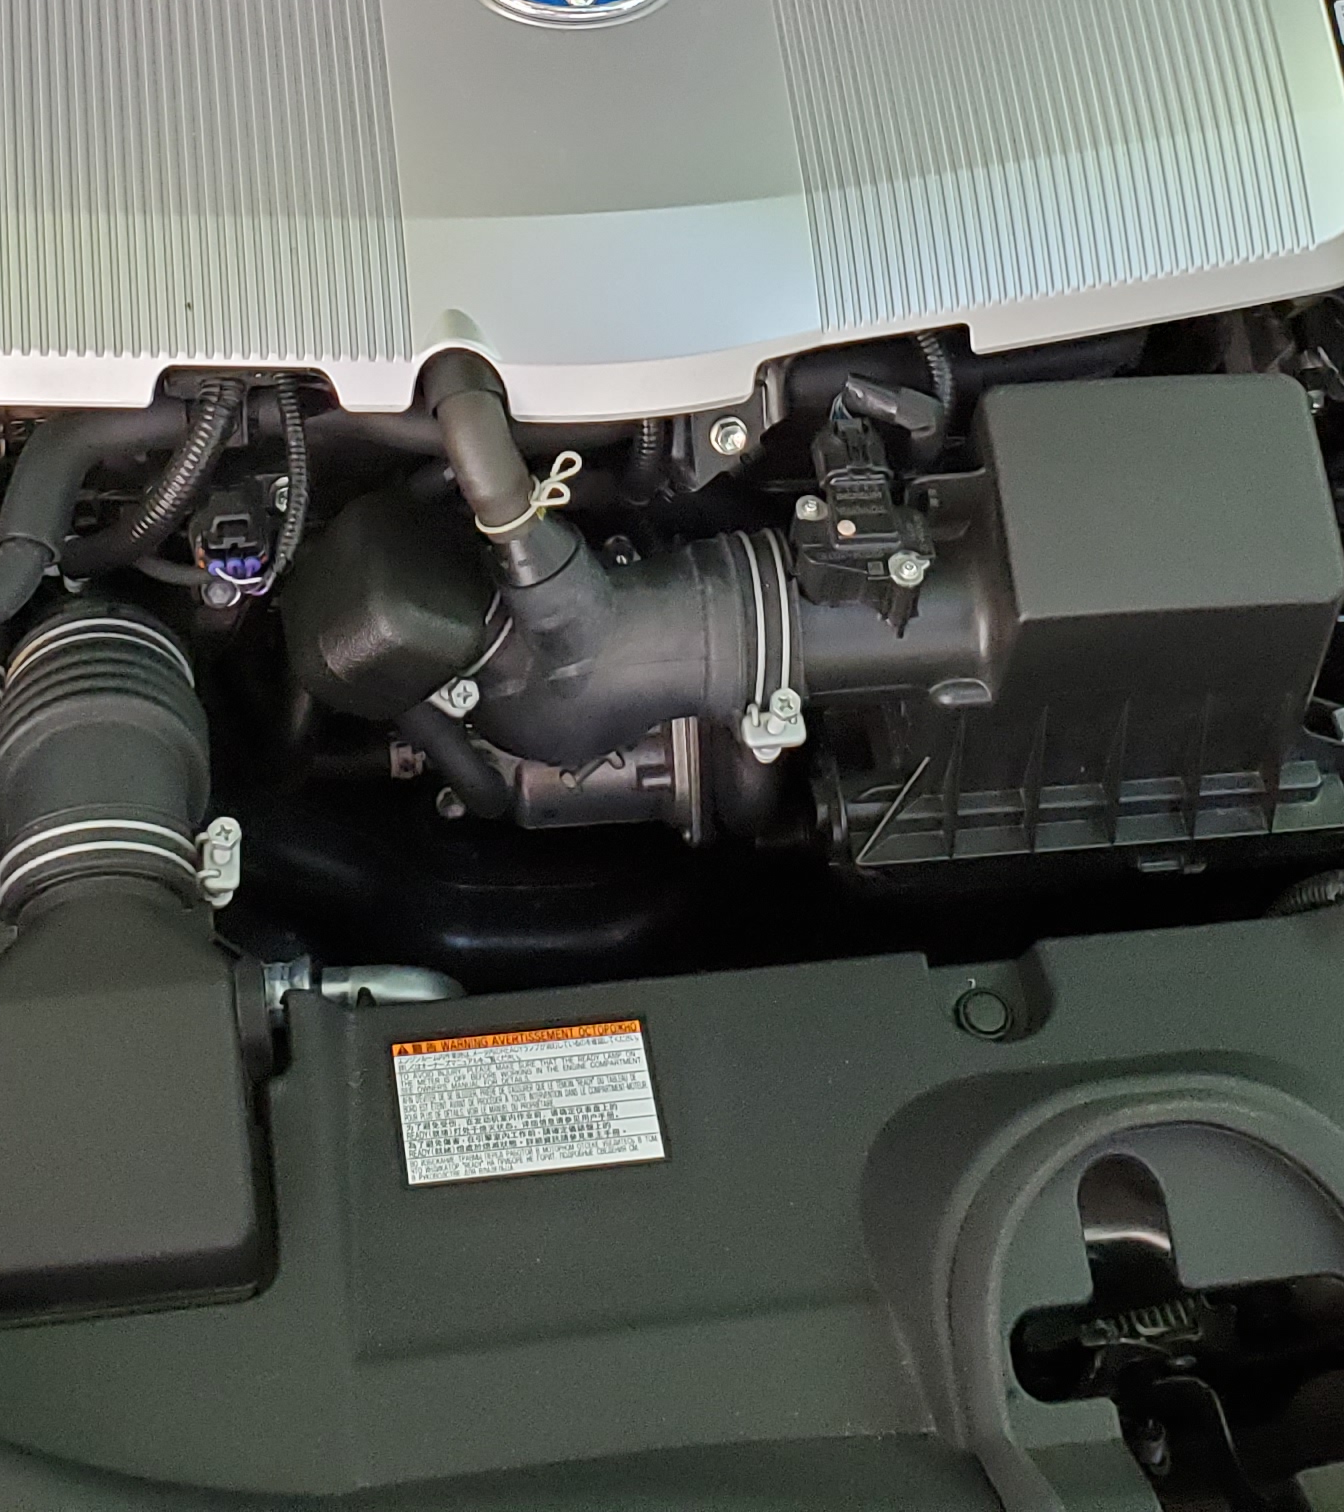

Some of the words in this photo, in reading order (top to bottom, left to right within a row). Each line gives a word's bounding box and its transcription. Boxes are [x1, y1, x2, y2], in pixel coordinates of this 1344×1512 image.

[440, 1037, 488, 1050] WARNING
[491, 1028, 573, 1045] AVERTISSEMENT
[495, 1062, 513, 1070] MAKE
[577, 1054, 599, 1062] READY
[417, 1077, 439, 1085] METER
[470, 1071, 496, 1080] BEFORE
[500, 1068, 532, 1077] WORKING
[562, 1062, 586, 1070] ENGINE
